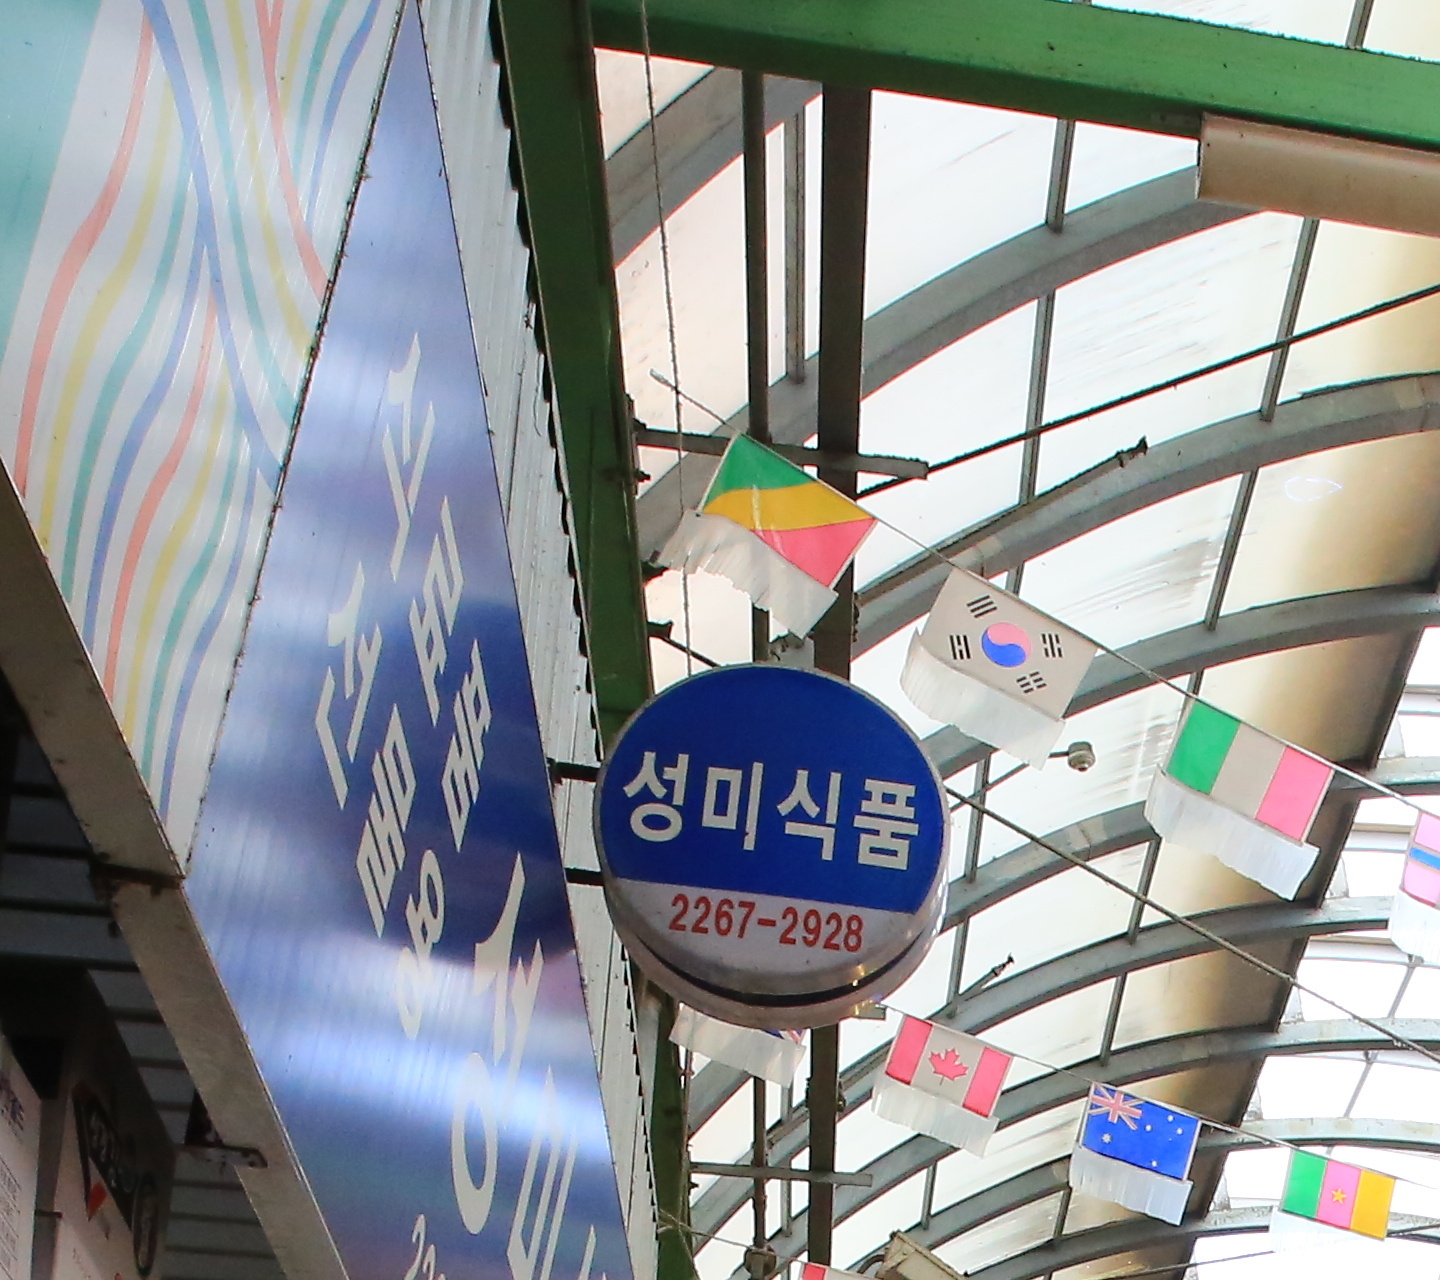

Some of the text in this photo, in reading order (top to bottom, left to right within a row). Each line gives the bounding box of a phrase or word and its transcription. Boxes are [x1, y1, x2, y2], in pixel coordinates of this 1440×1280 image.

[381, 333, 491, 851] 식료품
[315, 563, 446, 1041] 선물용
[621, 749, 920, 874] 성미식품
[669, 893, 865, 953] 2267-2928
